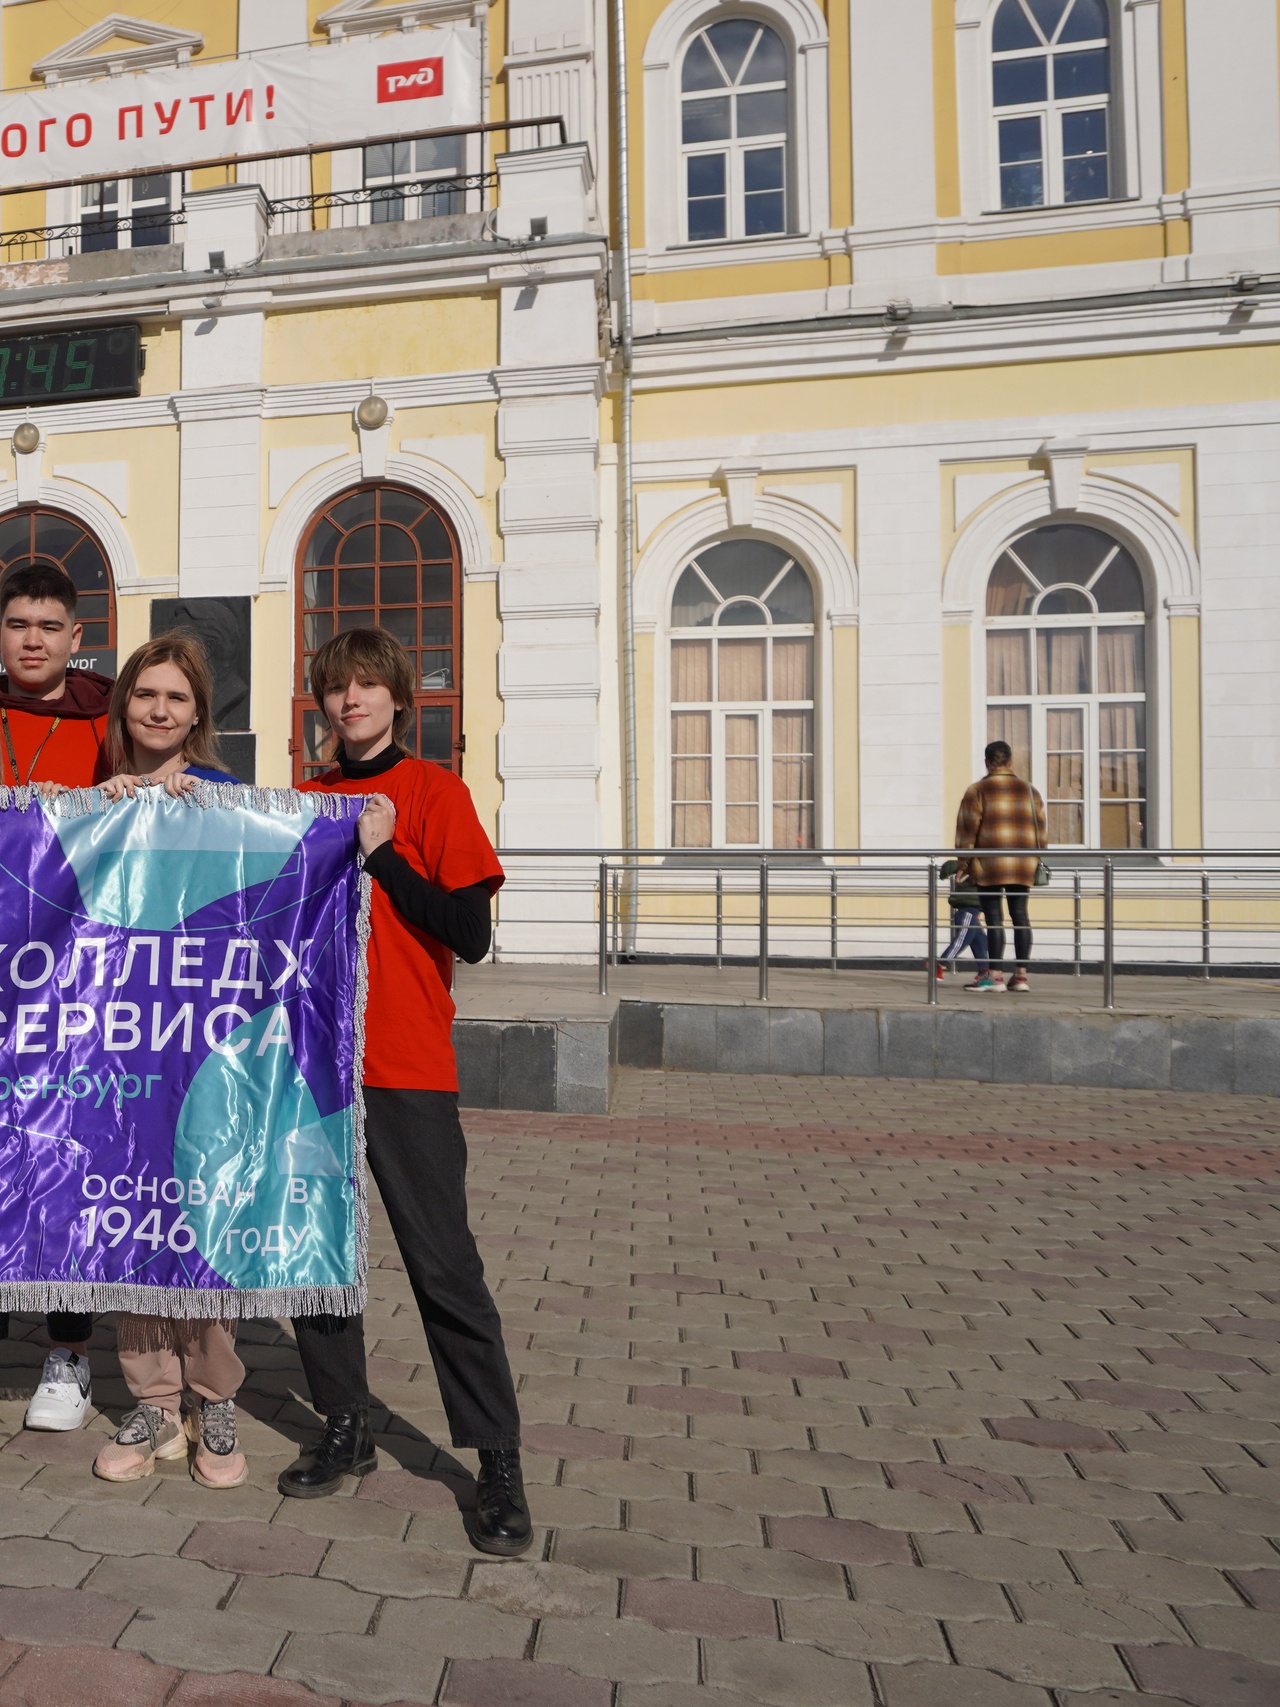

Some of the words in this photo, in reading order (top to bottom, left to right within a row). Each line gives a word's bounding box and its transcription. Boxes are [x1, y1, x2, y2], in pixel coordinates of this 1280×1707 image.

[118, 84, 275, 140] ПУТИ!
[81, 1174, 257, 1207] ОСНОВАН
[289, 1178, 309, 1204] В
[79, 1205, 197, 1254] 1946
